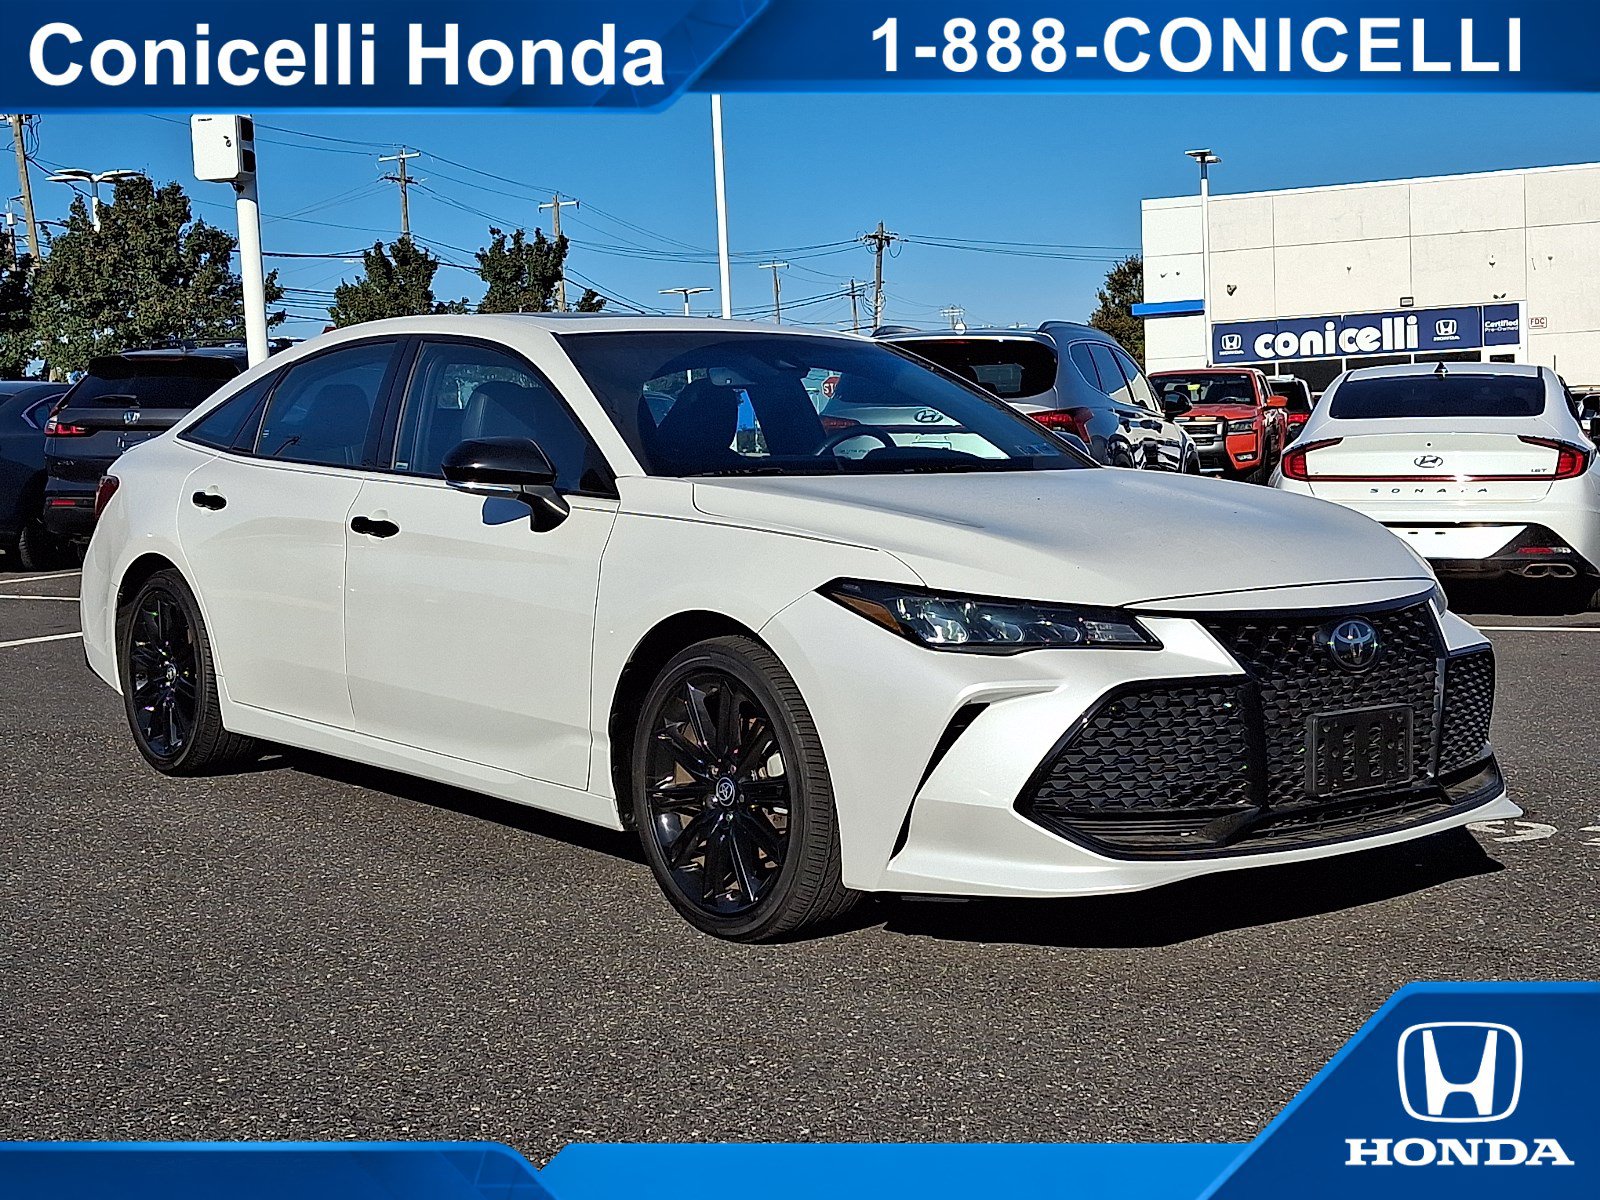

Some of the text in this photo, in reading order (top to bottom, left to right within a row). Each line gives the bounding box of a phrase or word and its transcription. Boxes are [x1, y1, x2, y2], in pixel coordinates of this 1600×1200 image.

[1484, 319, 1519, 327] Certified
[1530, 317, 1545, 325] FDC
[1254, 315, 1419, 359] conicelli
[823, 383, 837, 394] ST
